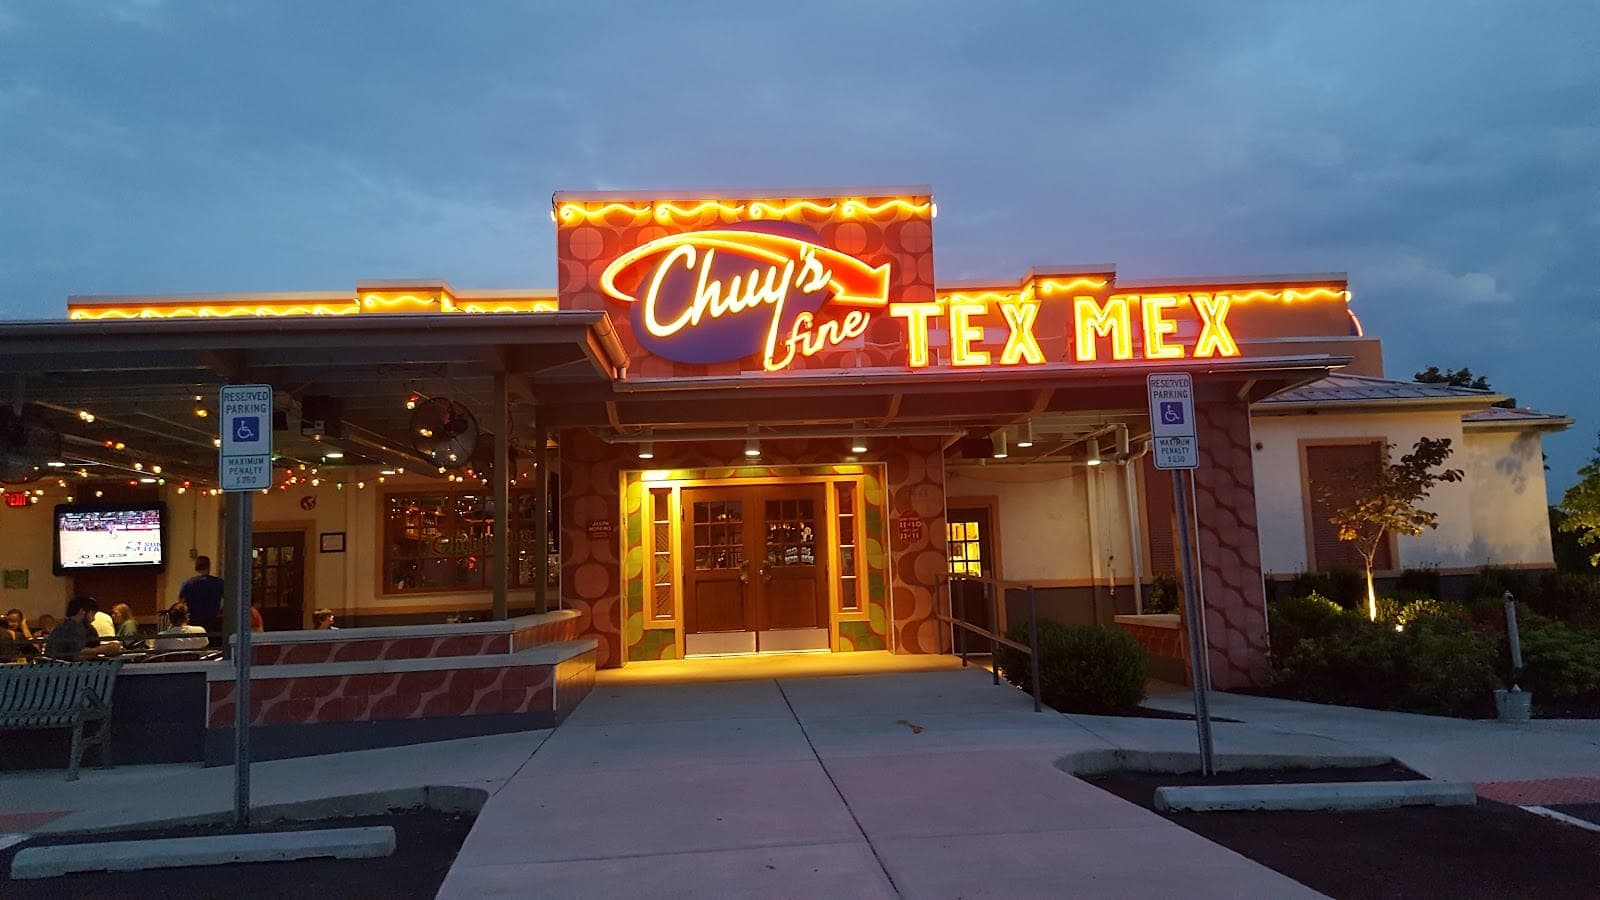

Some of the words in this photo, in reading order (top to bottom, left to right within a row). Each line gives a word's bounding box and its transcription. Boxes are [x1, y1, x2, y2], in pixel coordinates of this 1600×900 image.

[644, 243, 832, 372] Chuy's
[783, 311, 871, 361] fine
[889, 299, 1047, 368] TEX
[1073, 295, 1242, 362] MEX
[1151, 379, 1190, 388] RESERVED
[223, 391, 269, 402] RESERVED
[1153, 390, 1189, 399] PARKING
[226, 403, 267, 414] PARKING
[1161, 447, 1190, 455] PENALTY
[228, 457, 264, 466] MAXIMUM
[229, 466, 262, 475] PENALTY
